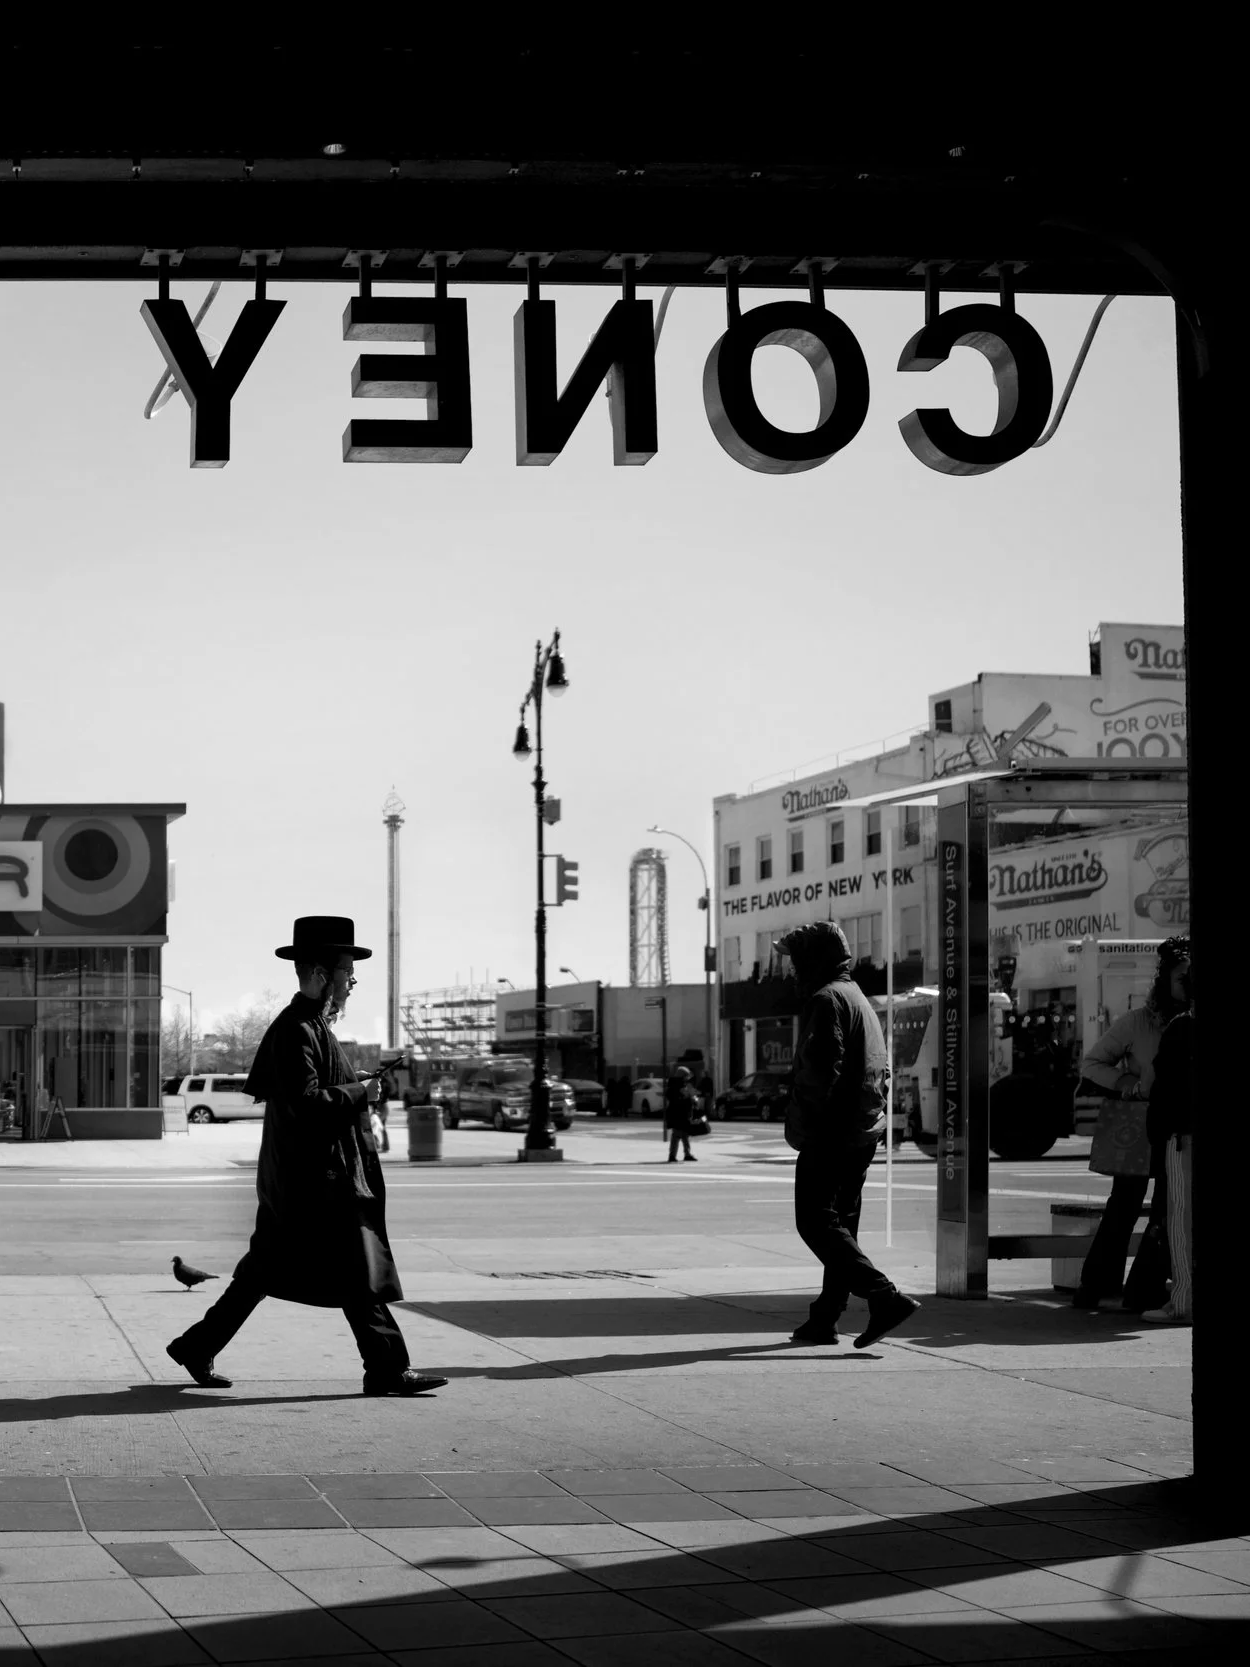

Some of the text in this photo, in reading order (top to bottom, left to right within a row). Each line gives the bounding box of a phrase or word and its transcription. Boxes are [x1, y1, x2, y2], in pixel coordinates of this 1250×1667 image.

[1103, 716, 1140, 737] FOR
[782, 777, 850, 815] Nathan's
[989, 848, 1104, 897] Nathan's
[723, 897, 748, 916] THE
[751, 883, 801, 912] FLAVOR
[805, 883, 823, 902] OF
[828, 874, 863, 898] NEW
[1026, 920, 1051, 941] THE
[1055, 912, 1122, 938] ORIGINAL
[945, 845, 957, 1180] Surf Avenue & Stillwell Avenue
